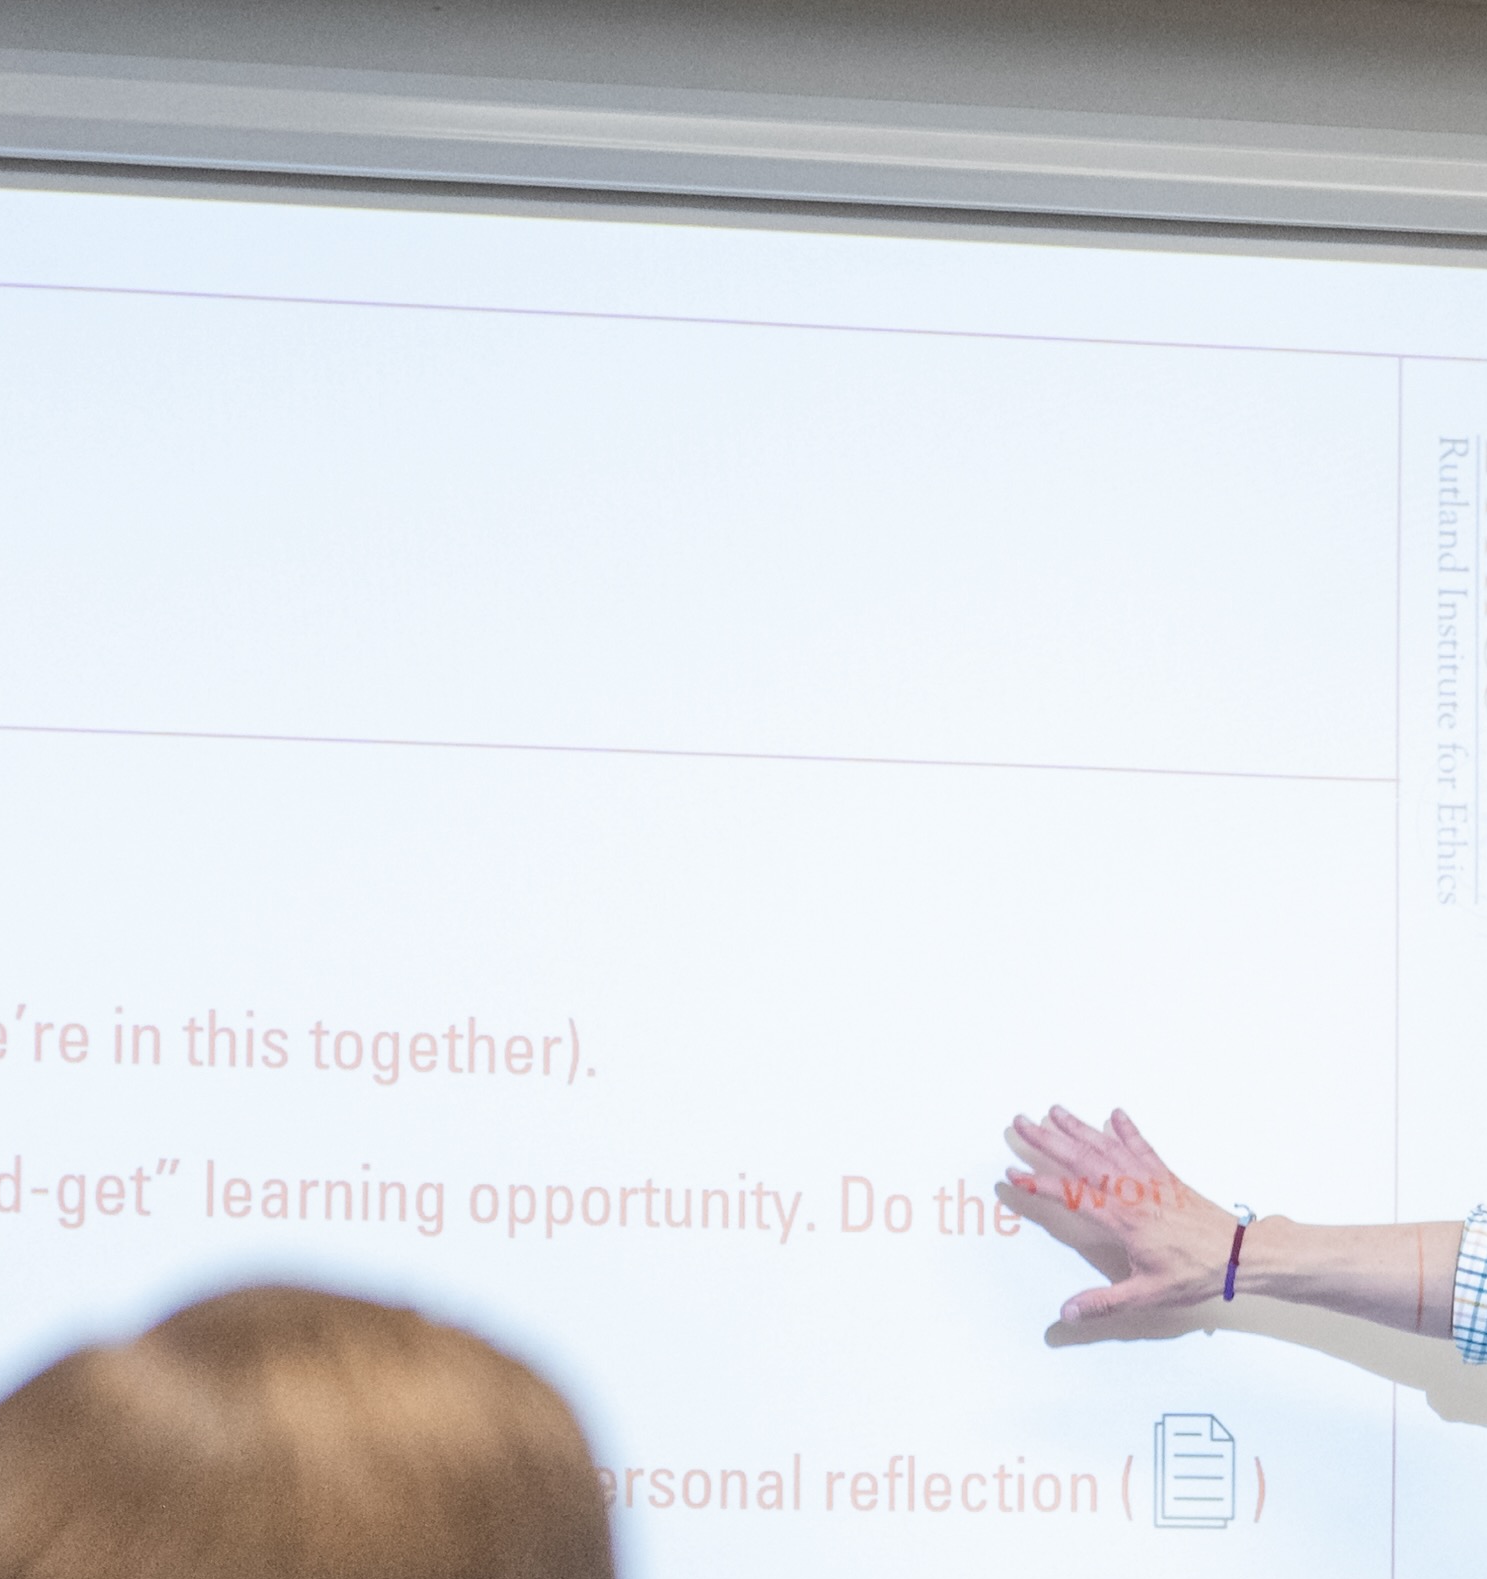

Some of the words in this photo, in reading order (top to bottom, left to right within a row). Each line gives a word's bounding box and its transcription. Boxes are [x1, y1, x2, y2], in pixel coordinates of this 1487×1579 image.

[1437, 434, 1472, 575] Rutland
[1437, 586, 1470, 732] Institute
[1437, 742, 1469, 792] for
[1437, 801, 1469, 906] Ethics
[113, 1007, 163, 1066] in
[184, 1009, 290, 1070] this
[309, 1016, 598, 1087] together).
[204, 1159, 446, 1237] learning
[468, 1171, 817, 1244] opportunity.
[840, 1173, 914, 1235] Do
[932, 1175, 1023, 1237] the
[597, 1454, 803, 1514] ersonal
[824, 1455, 1100, 1514] reflection
